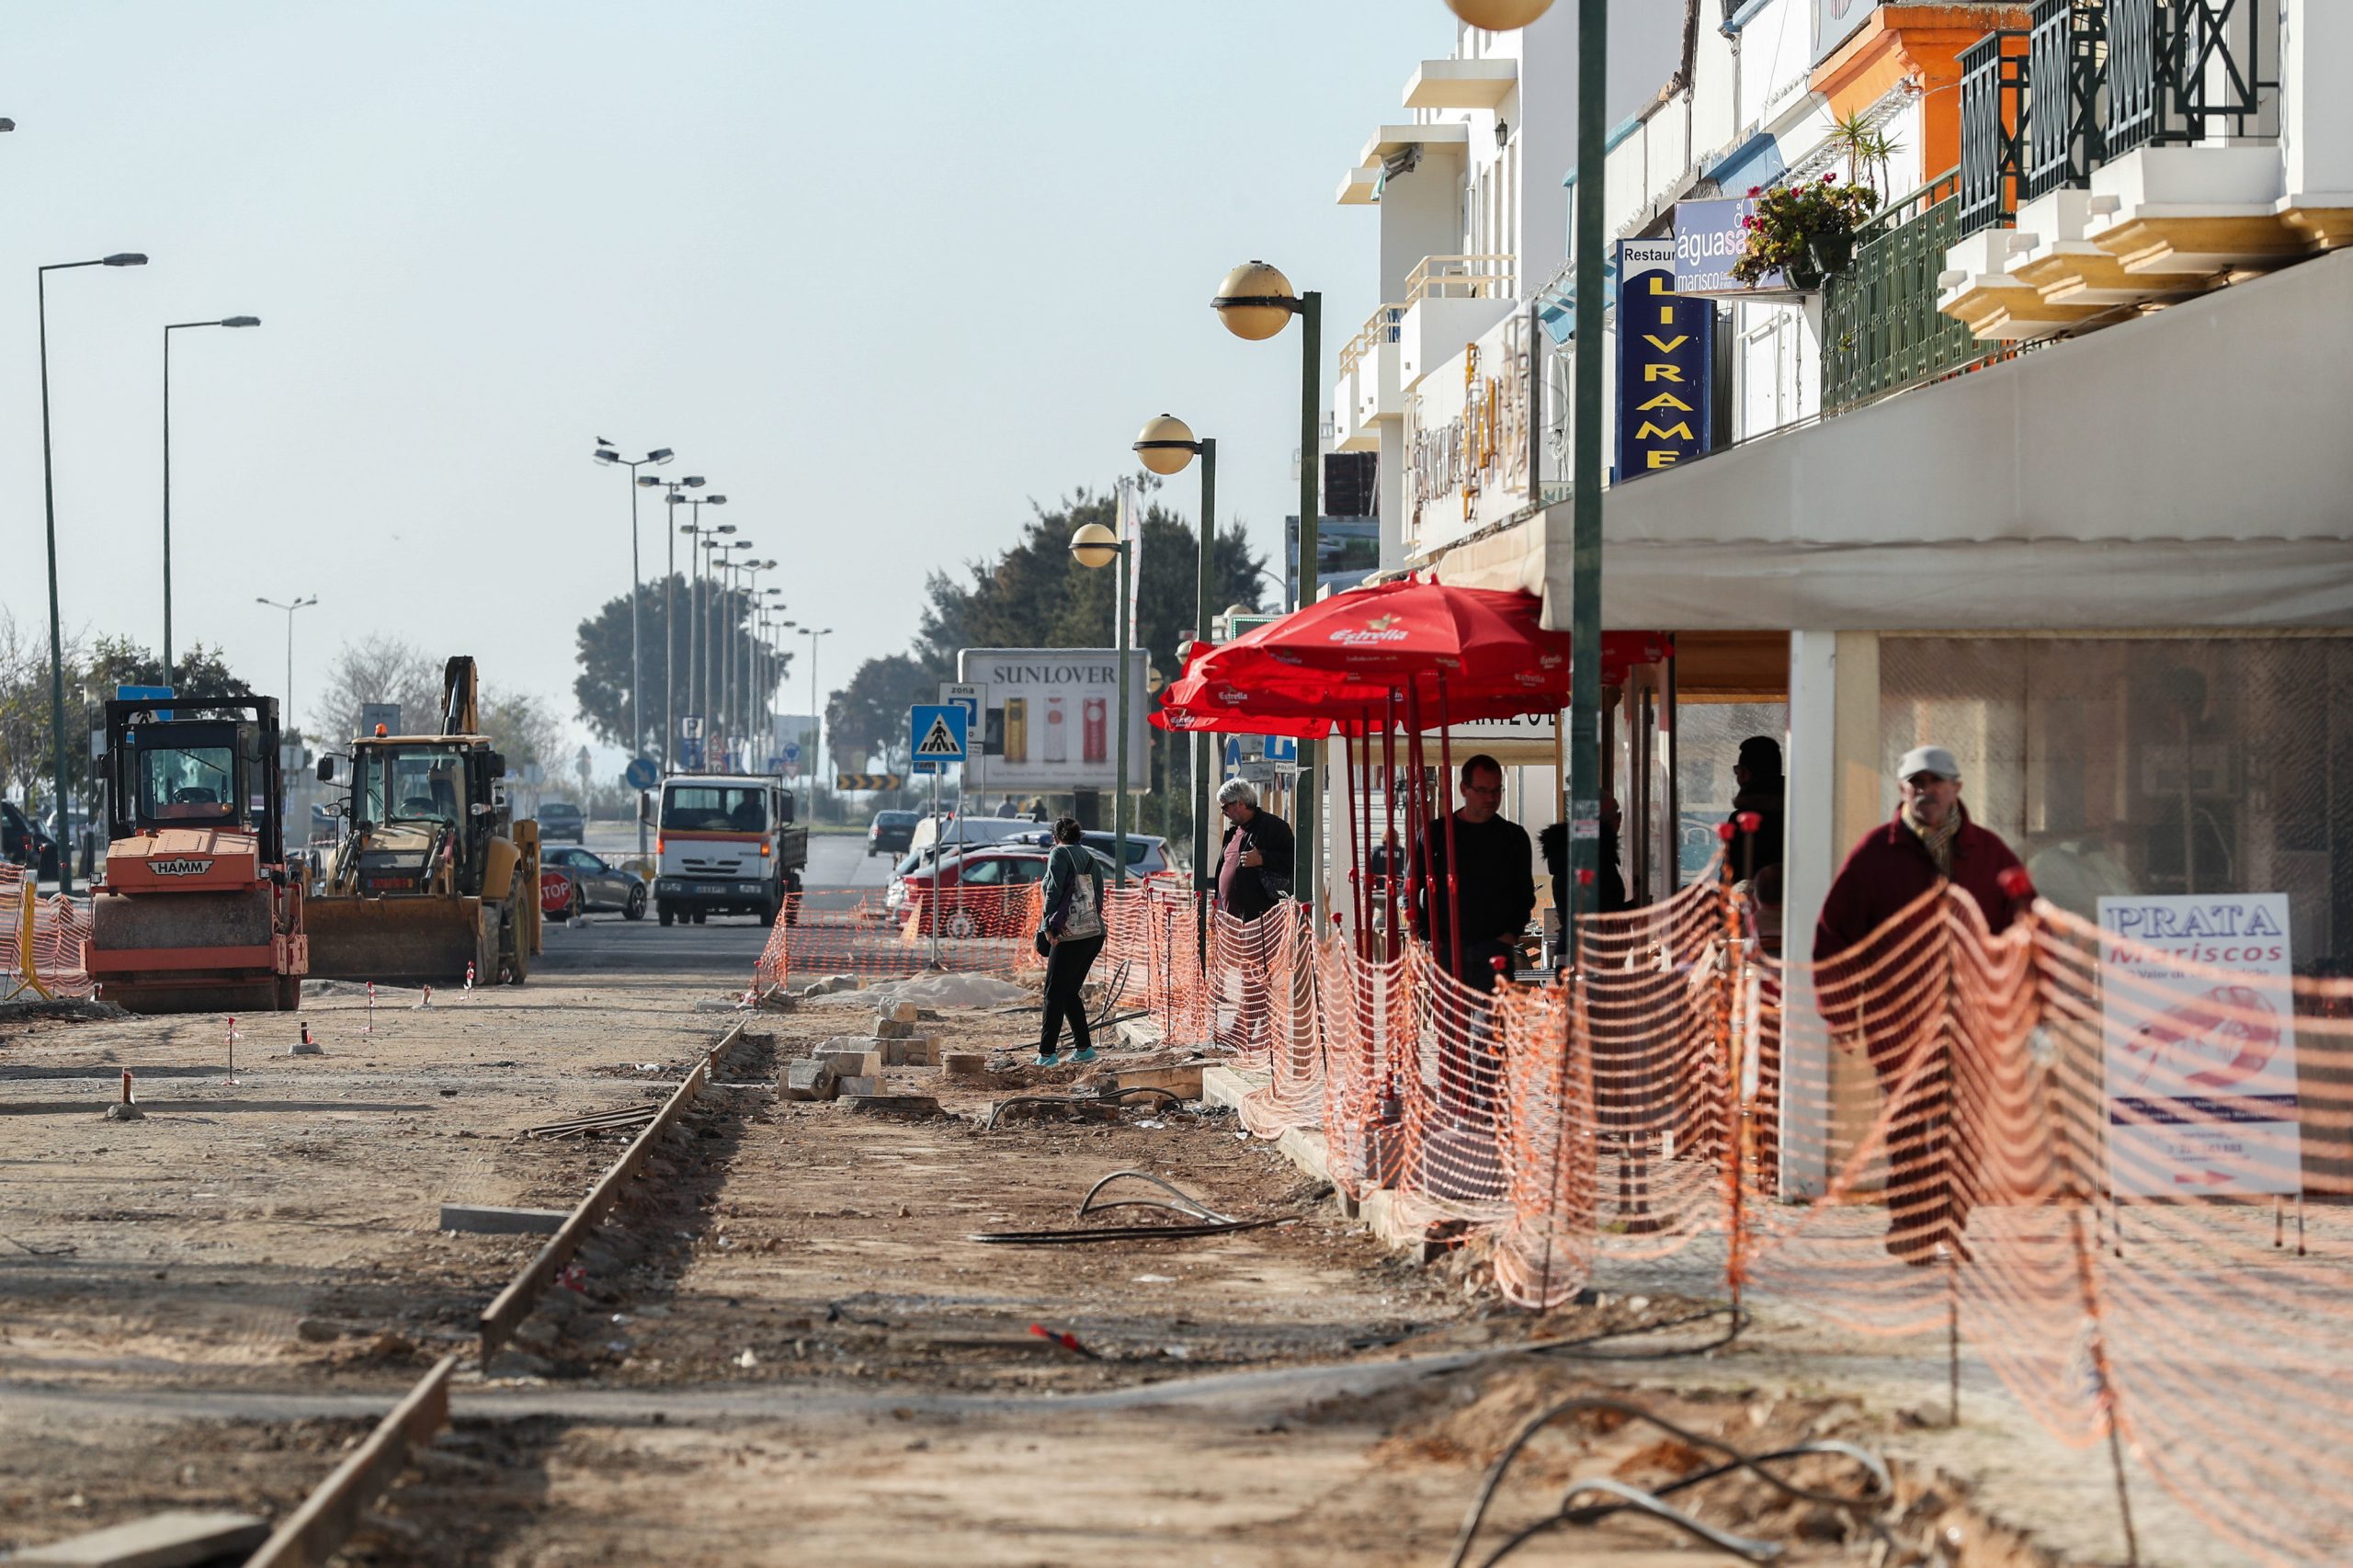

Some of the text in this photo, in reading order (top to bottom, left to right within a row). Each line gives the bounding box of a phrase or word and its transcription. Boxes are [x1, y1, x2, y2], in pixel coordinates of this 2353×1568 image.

[1624, 248, 1675, 261] Restaur
[1677, 227, 1750, 267] águasa
[1677, 270, 1719, 292] marisco
[1635, 278, 1694, 469] LIVRAME
[1329, 629, 1409, 642] Estrella
[994, 666, 1118, 684] SUNLOVER
[158, 862, 203, 873] HAMM
[540, 882, 568, 899] TOP
[2106, 904, 2282, 938] PRATA
